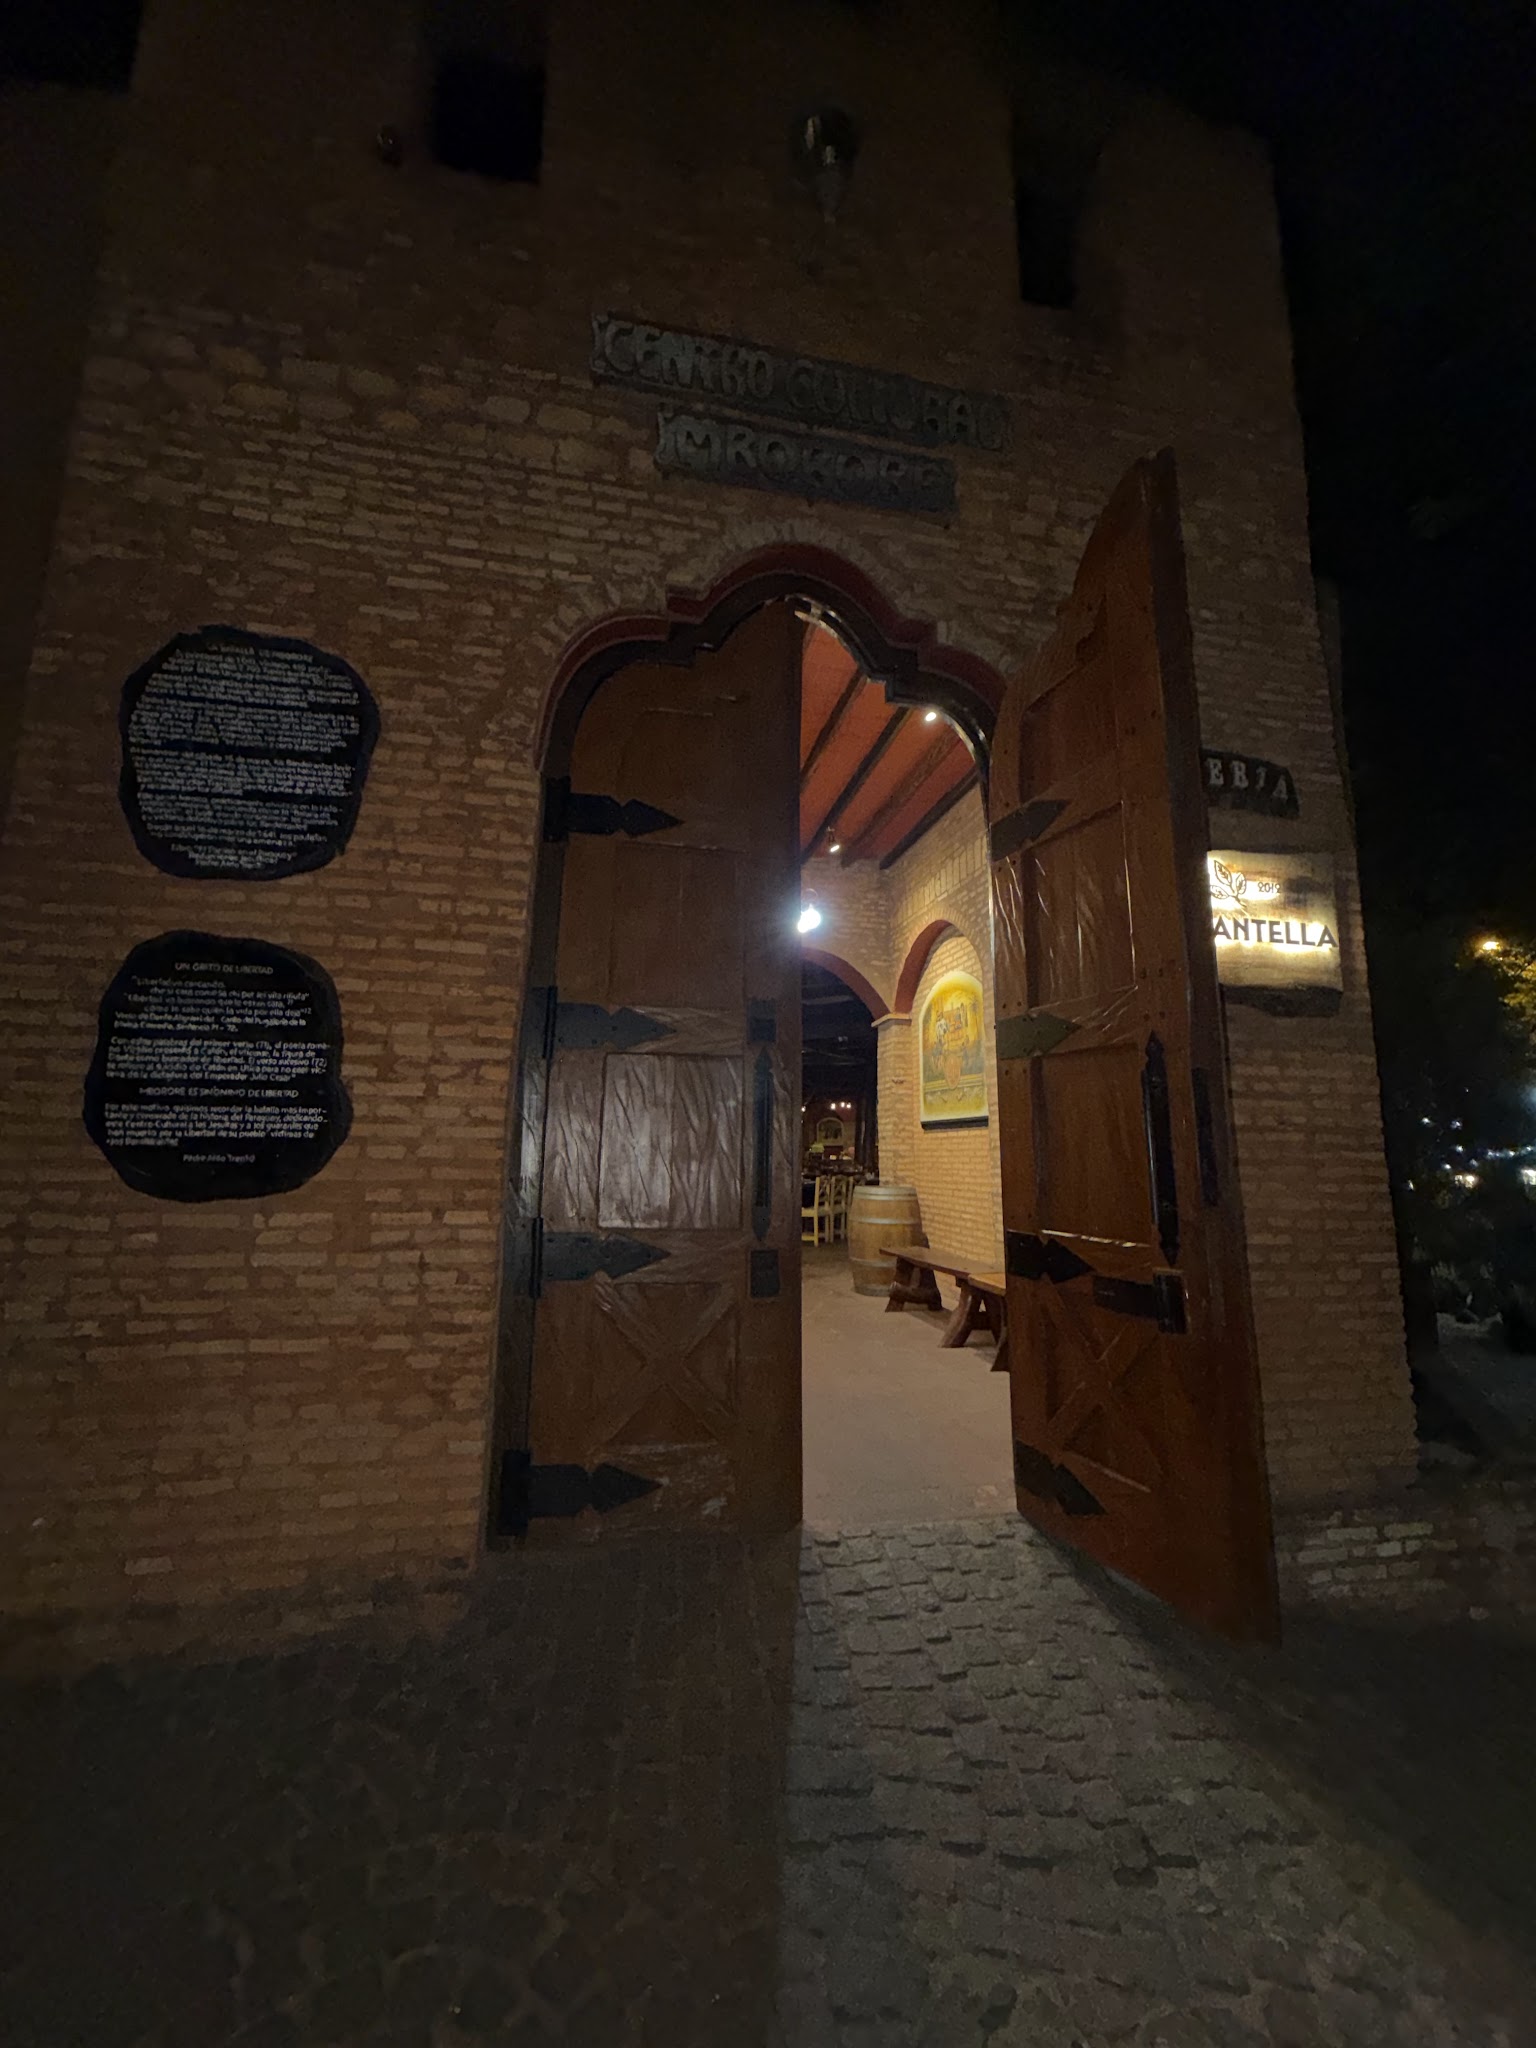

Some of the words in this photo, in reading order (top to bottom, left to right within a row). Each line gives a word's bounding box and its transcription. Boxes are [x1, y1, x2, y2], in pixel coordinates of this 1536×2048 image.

[222, 963, 234, 973] DE
[235, 964, 274, 975] LIBERTAD
[256, 1058, 277, 1066] verso
[247, 1089, 260, 1098] DE
[261, 1089, 299, 1098] LIBERTAD
